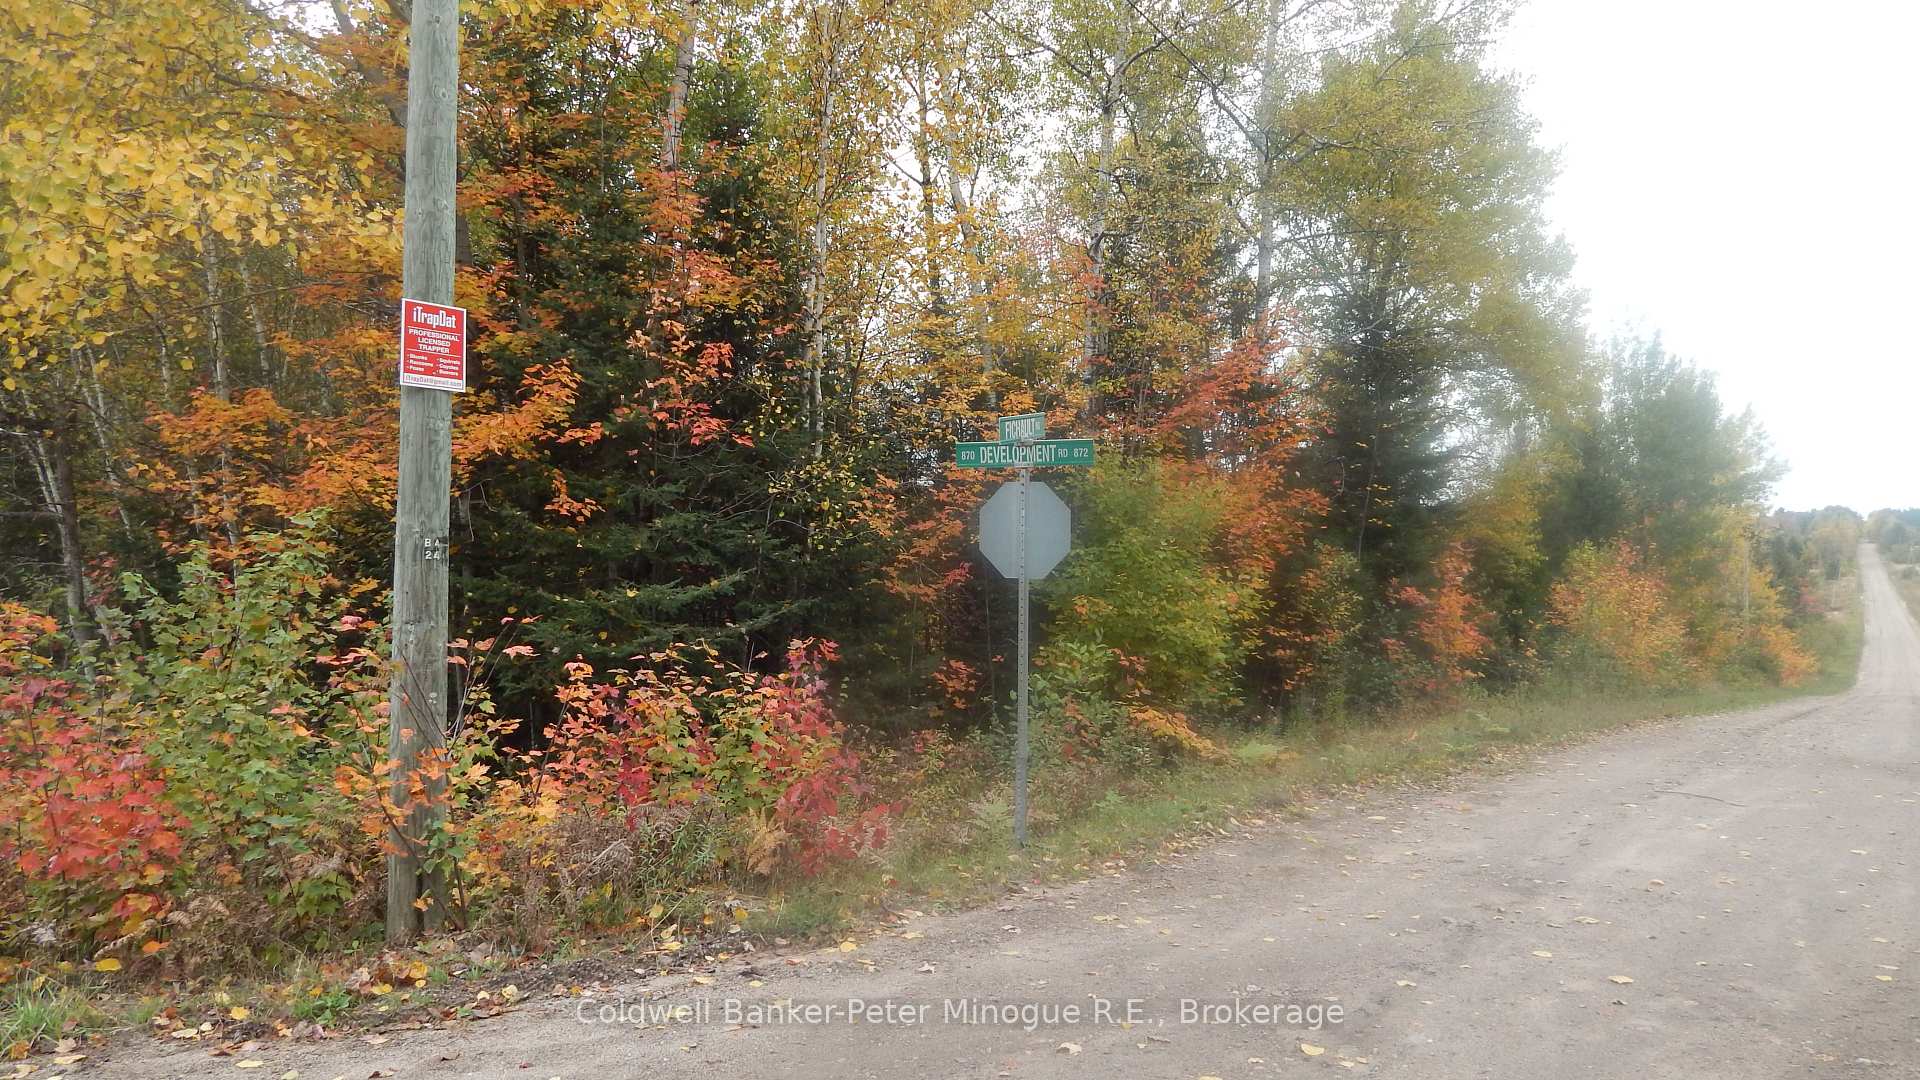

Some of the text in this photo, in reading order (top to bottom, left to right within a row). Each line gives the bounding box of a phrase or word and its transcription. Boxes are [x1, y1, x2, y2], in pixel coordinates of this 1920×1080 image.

[413, 306, 456, 328] iTrapDat
[408, 329, 460, 342] PROFESSIONAL
[417, 337, 451, 347] LICENSED
[419, 344, 450, 353] TRAPPER
[1005, 418, 1035, 440] FICHAULT
[961, 445, 1089, 464] 870 DEVELOPMENT RD 872
